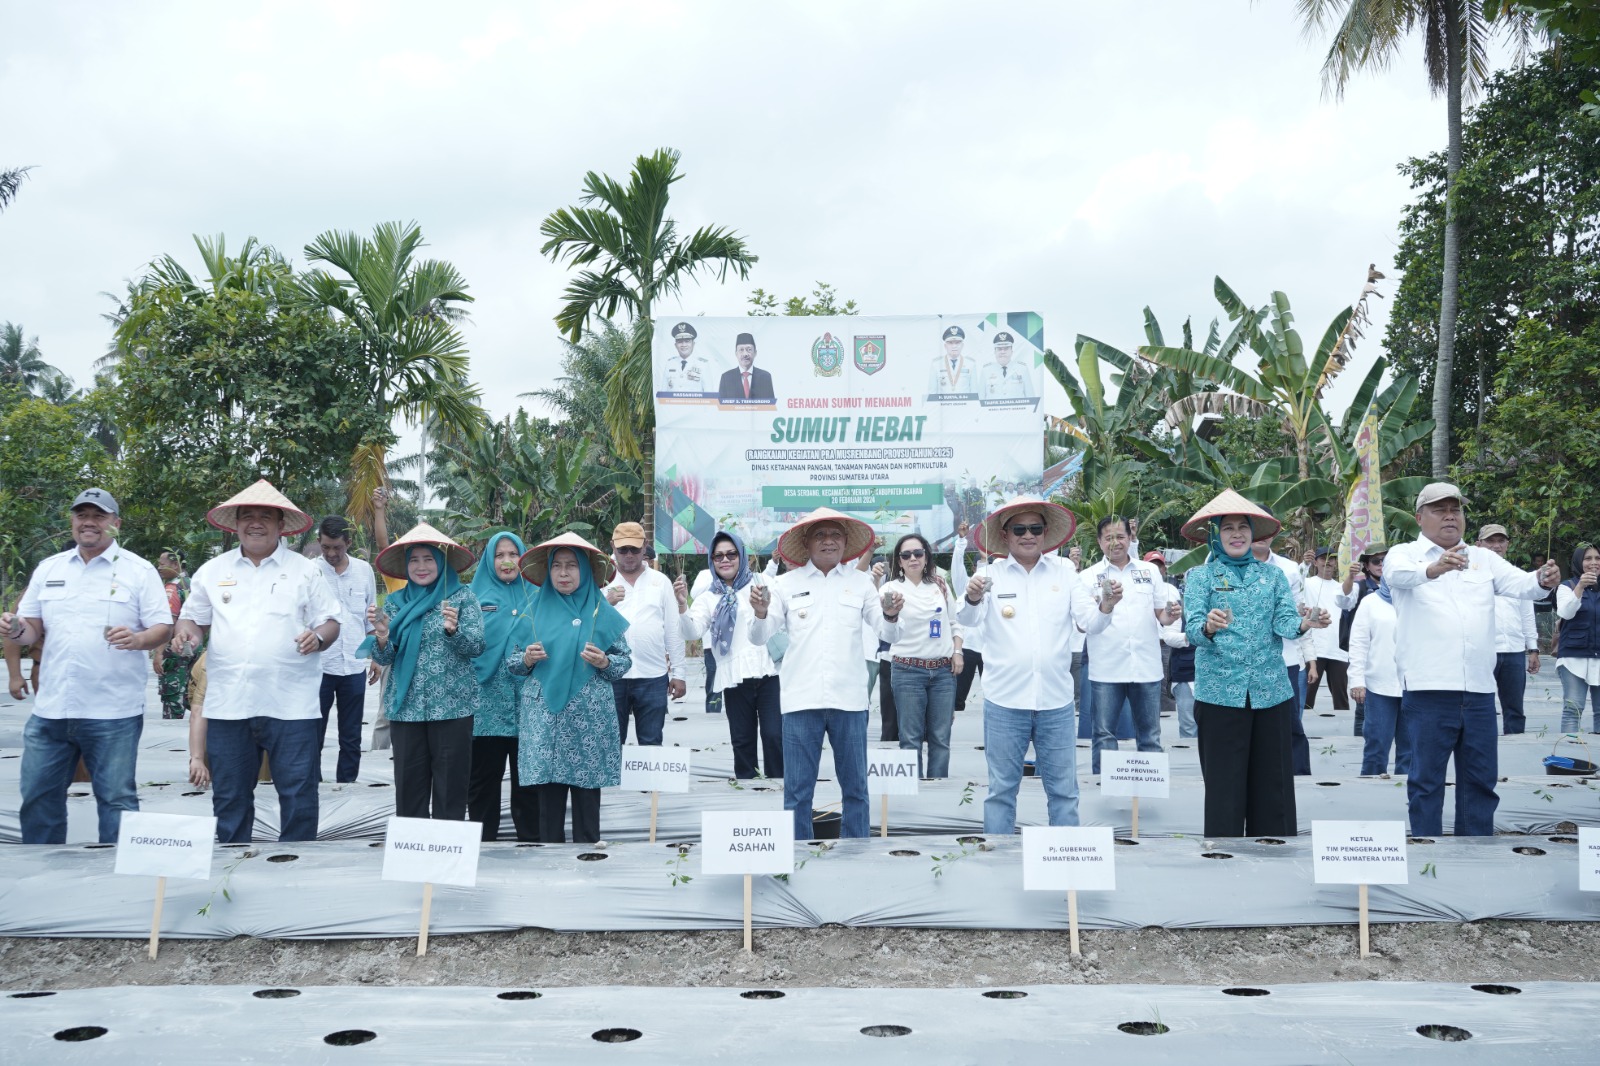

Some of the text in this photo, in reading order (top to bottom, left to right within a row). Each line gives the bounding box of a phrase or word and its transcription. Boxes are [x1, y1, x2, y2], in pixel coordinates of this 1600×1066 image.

[787, 396, 912, 409] GERAKAN SUMUT MENANAM
[770, 415, 928, 443] SUMUT HEBAT
[745, 446, 953, 461] (RANGKAIAN KEGIATAN PRA MUSRENBANG PROVSU TAHUN 2025)
[838, 473, 869, 481] SUMATERA
[784, 489, 797, 497] DESA
[822, 488, 850, 496] KECAMATAN
[851, 488, 874, 496] MERANT
[903, 487, 923, 495] ASAHAN
[839, 496, 862, 504] FEBRUARI
[624, 760, 688, 773] KEPALA DESA
[867, 763, 917, 777] AMAT
[733, 827, 772, 837] BUPATI
[130, 836, 193, 848] FORKOPINDA
[394, 841, 463, 854] WAKIL BUPATI
[728, 842, 775, 852] ASAHAN
